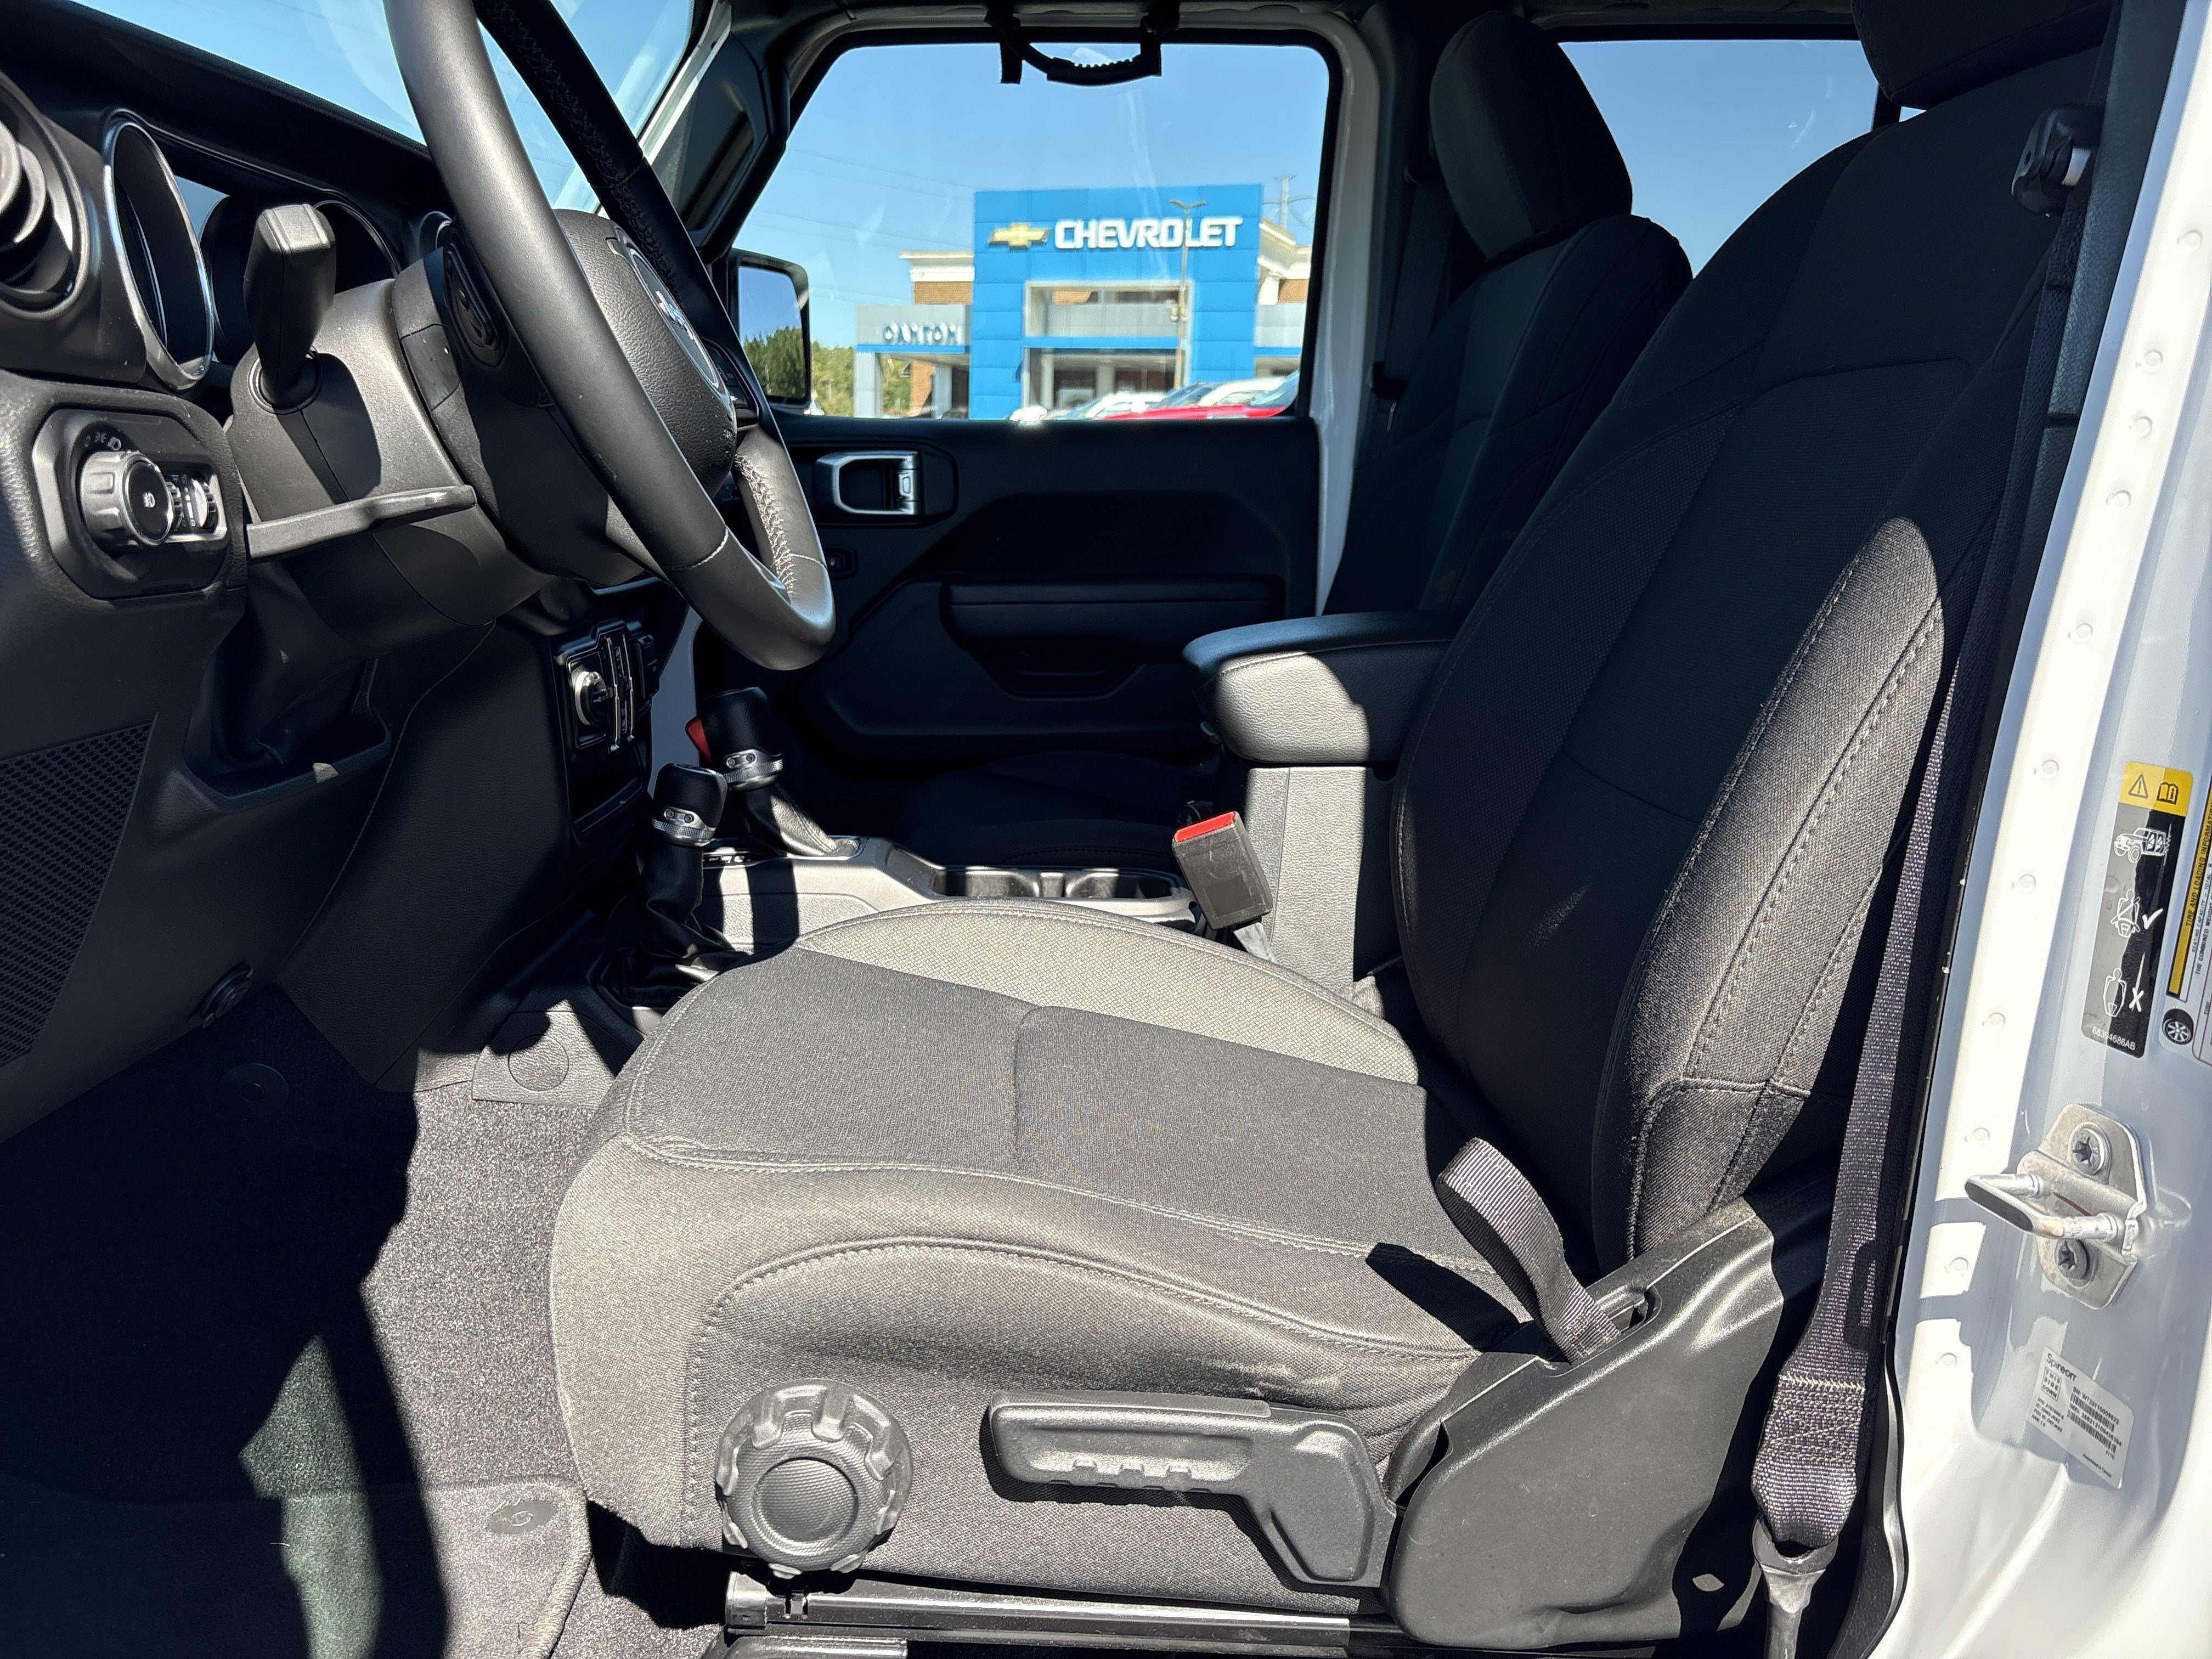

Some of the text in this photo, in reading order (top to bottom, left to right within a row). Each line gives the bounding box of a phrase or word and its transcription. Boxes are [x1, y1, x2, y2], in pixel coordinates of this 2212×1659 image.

[1054, 216, 1244, 249] CHEVROLET
[2186, 910, 2194, 926] TIRE
[2193, 857, 2205, 890] LOADING
[2198, 929, 2209, 961] COMBINED
[2046, 1369, 2060, 1384] THIS
[2047, 1353, 2076, 1381] Spireon
[2042, 1384, 2057, 1398] DOWN
[2044, 1377, 2058, 1391] SIDE
